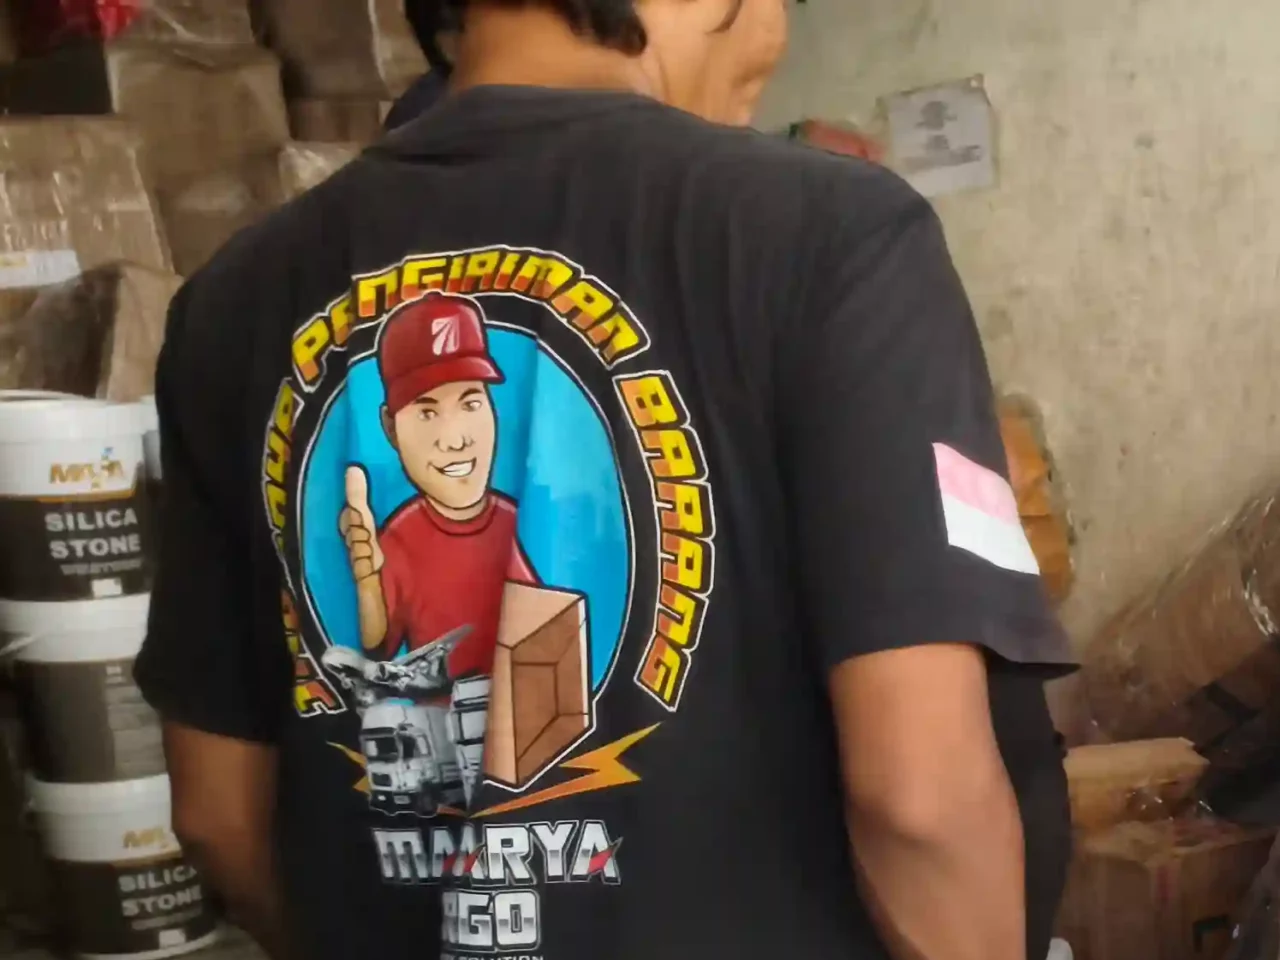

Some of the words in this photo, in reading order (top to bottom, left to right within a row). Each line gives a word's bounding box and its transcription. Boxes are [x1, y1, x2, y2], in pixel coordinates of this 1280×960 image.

[44, 508, 138, 532] SILICA
[49, 534, 141, 559] STONE
[613, 370, 716, 711] BARANG
